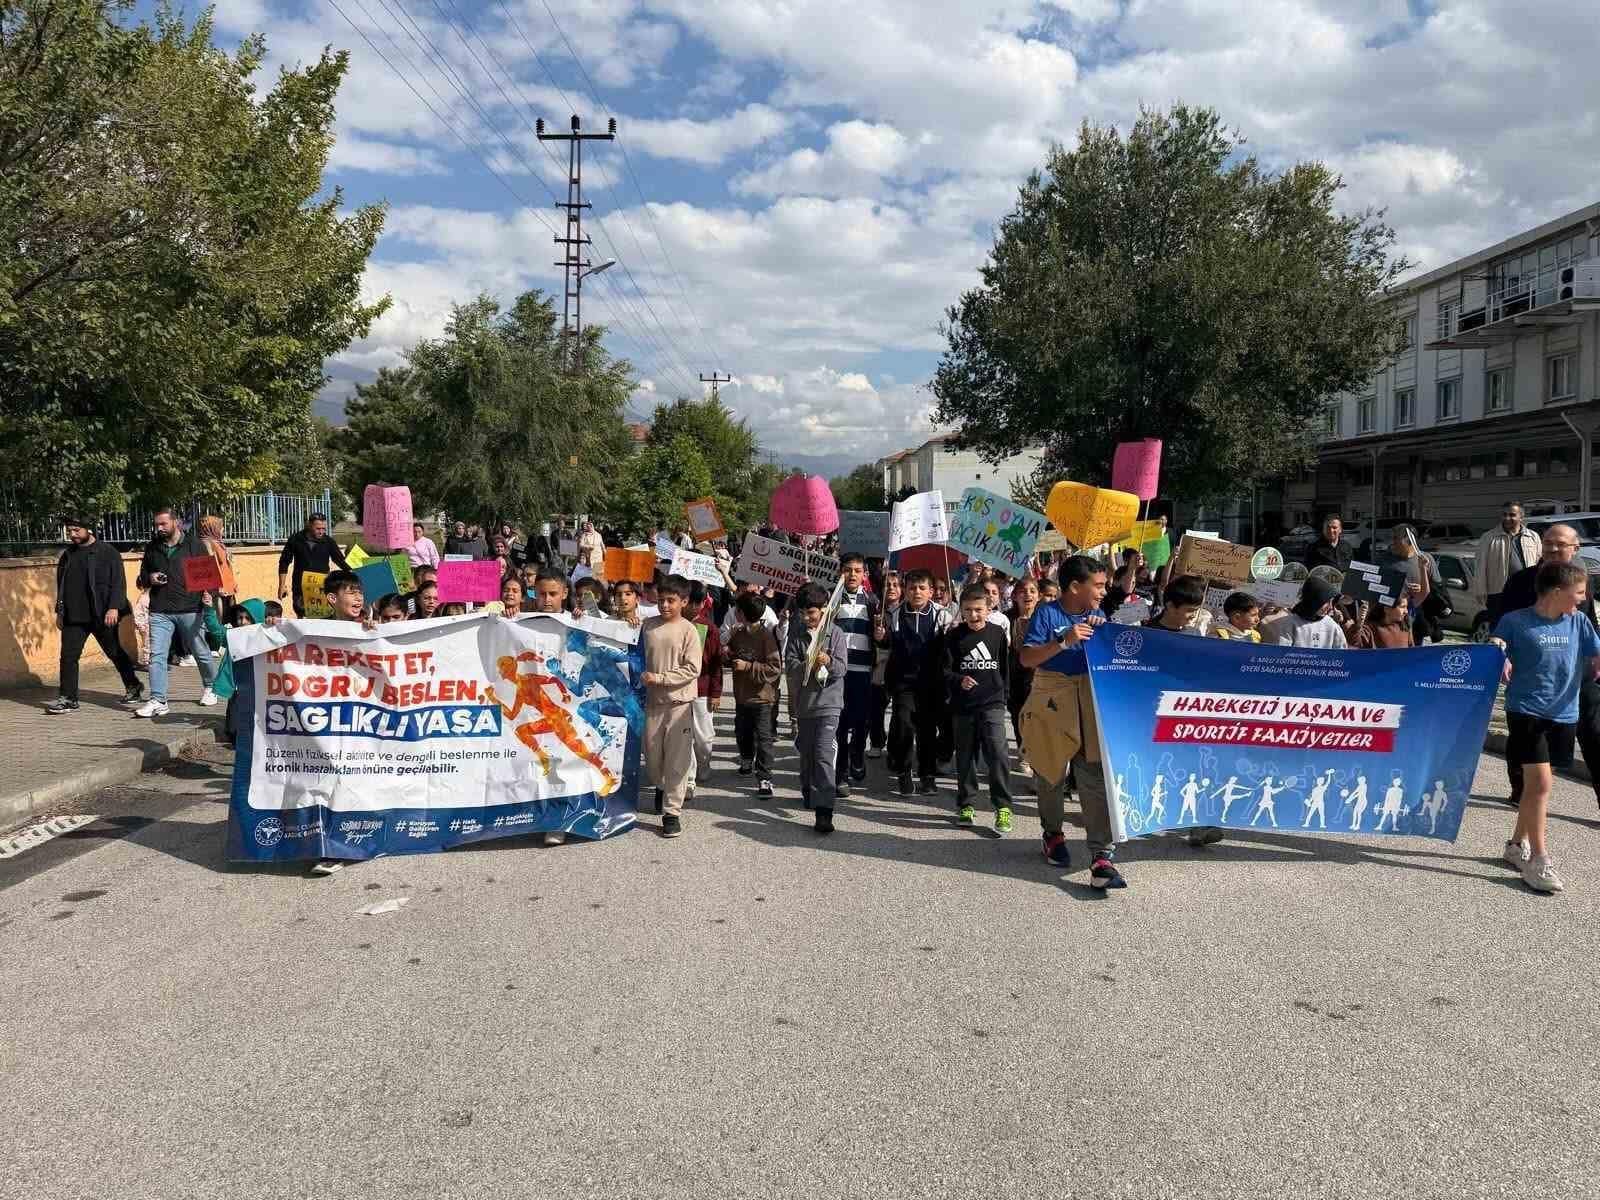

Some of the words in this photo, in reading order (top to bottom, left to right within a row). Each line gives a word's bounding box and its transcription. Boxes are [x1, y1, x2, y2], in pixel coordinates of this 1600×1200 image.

[751, 561, 801, 586] ERZİNCA
[1540, 633, 1569, 645] Storm
[403, 651, 436, 677] ET,
[960, 659, 998, 670] adidas
[381, 680, 486, 707] BESLEN,
[1173, 697, 1281, 716] HAREKETLİ
[1281, 702, 1356, 722] YAŞAM
[1361, 708, 1386, 723] VE
[1173, 721, 1249, 741] SPORTİF
[1251, 726, 1374, 748] FAALİYETLER
[265, 747, 303, 759] Düzenli
[378, 753, 394, 761] ve
[440, 749, 501, 760] beslenme
[503, 748, 518, 759] ile
[265, 762, 301, 773] kronik
[362, 763, 394, 774] önüne
[396, 763, 459, 776] geçilebilir.
